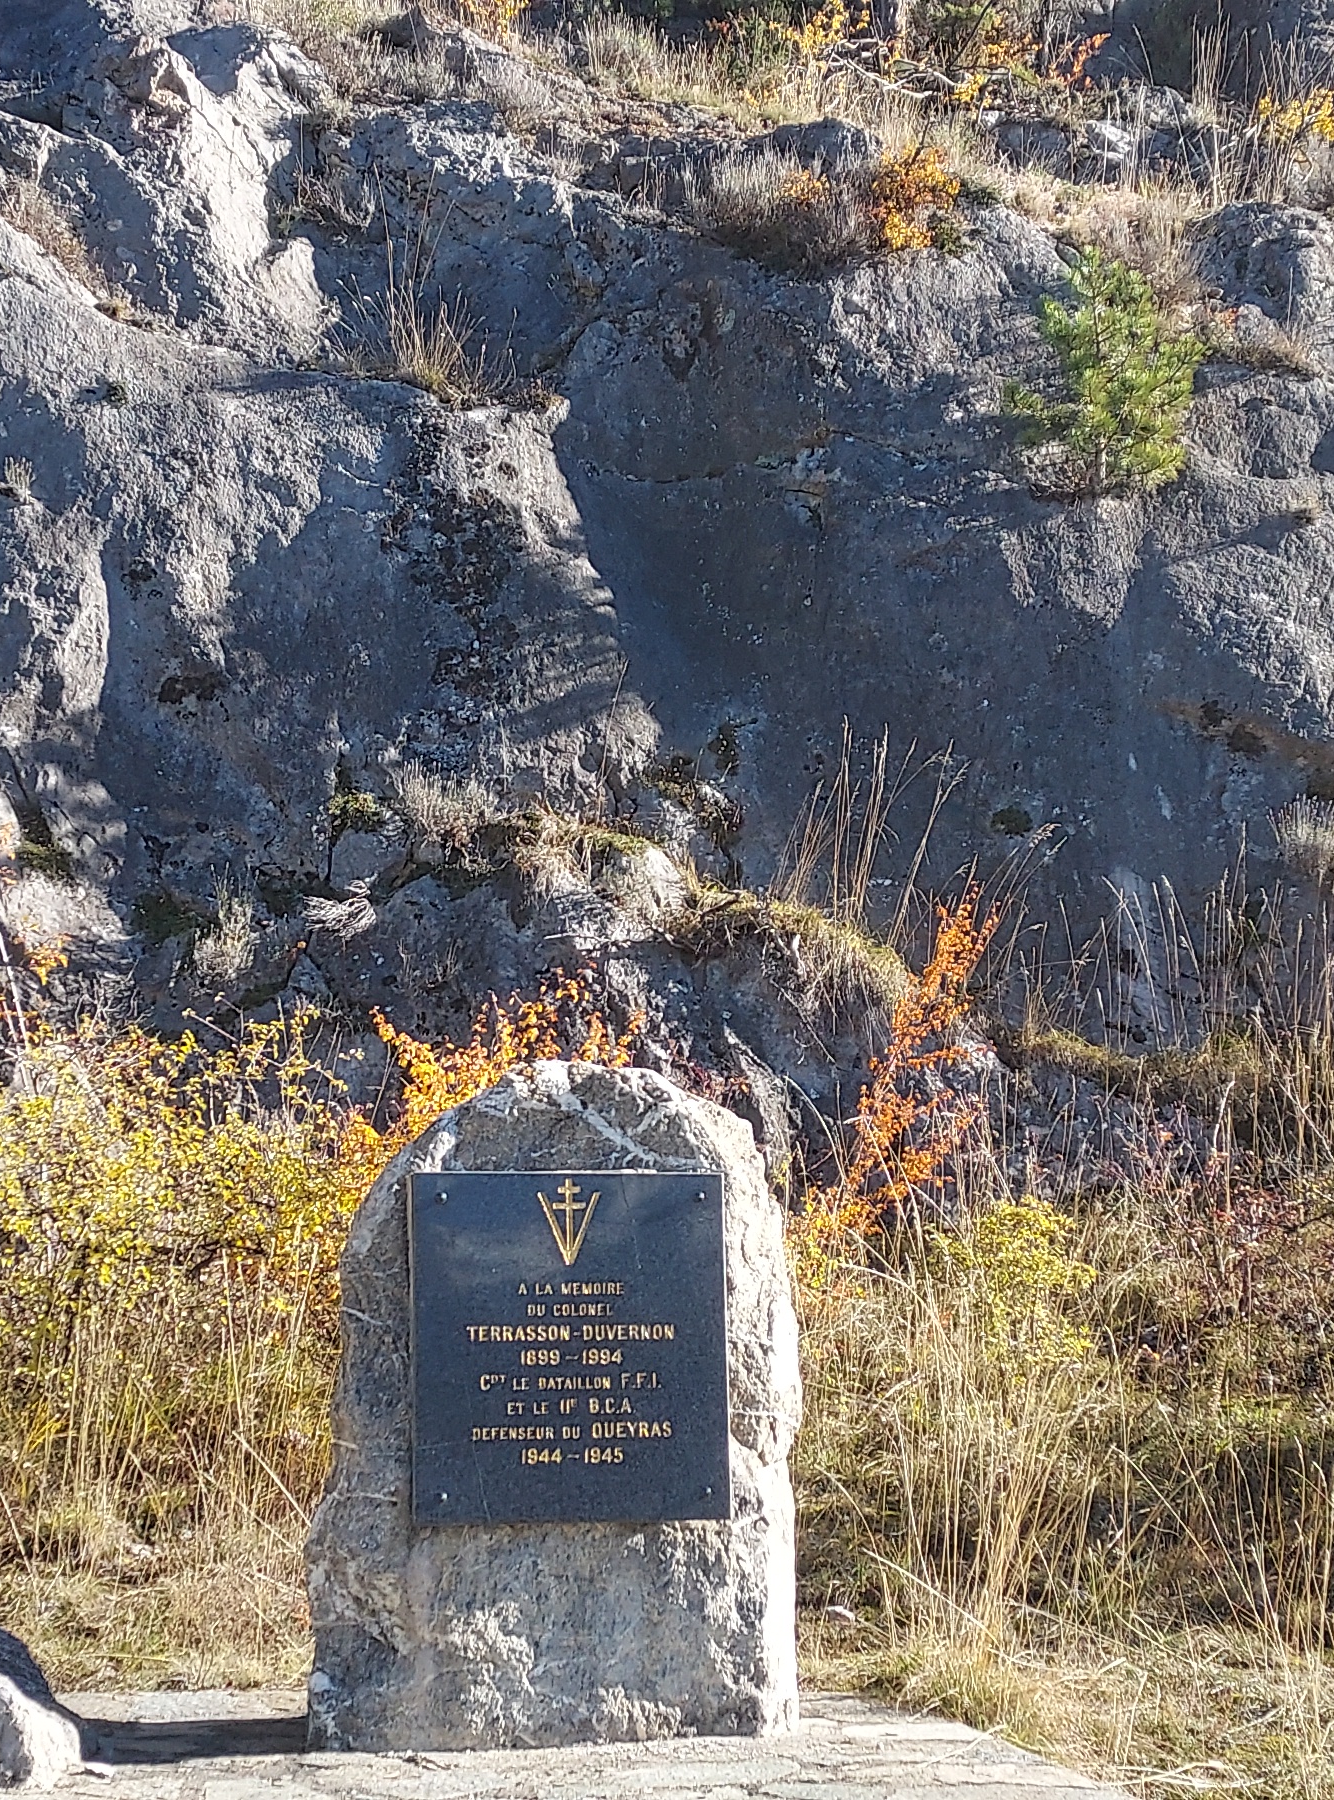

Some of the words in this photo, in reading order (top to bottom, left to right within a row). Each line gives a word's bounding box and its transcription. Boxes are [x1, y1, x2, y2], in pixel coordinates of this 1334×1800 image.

[535, 1282, 553, 1295] LA
[527, 1304, 546, 1317] DU
[553, 1303, 614, 1317] COLONEL
[466, 1324, 675, 1342] TERRASSON-DUVERNON
[513, 1377, 530, 1391] LE
[538, 1376, 611, 1391] BATAILLON
[620, 1372, 662, 1390] F.F.I.
[507, 1402, 525, 1415] ET
[533, 1401, 549, 1415] LE
[471, 1426, 555, 1441] DEFENSEUR
[562, 1426, 581, 1440] DU
[592, 1421, 672, 1438] QUEYRAS
